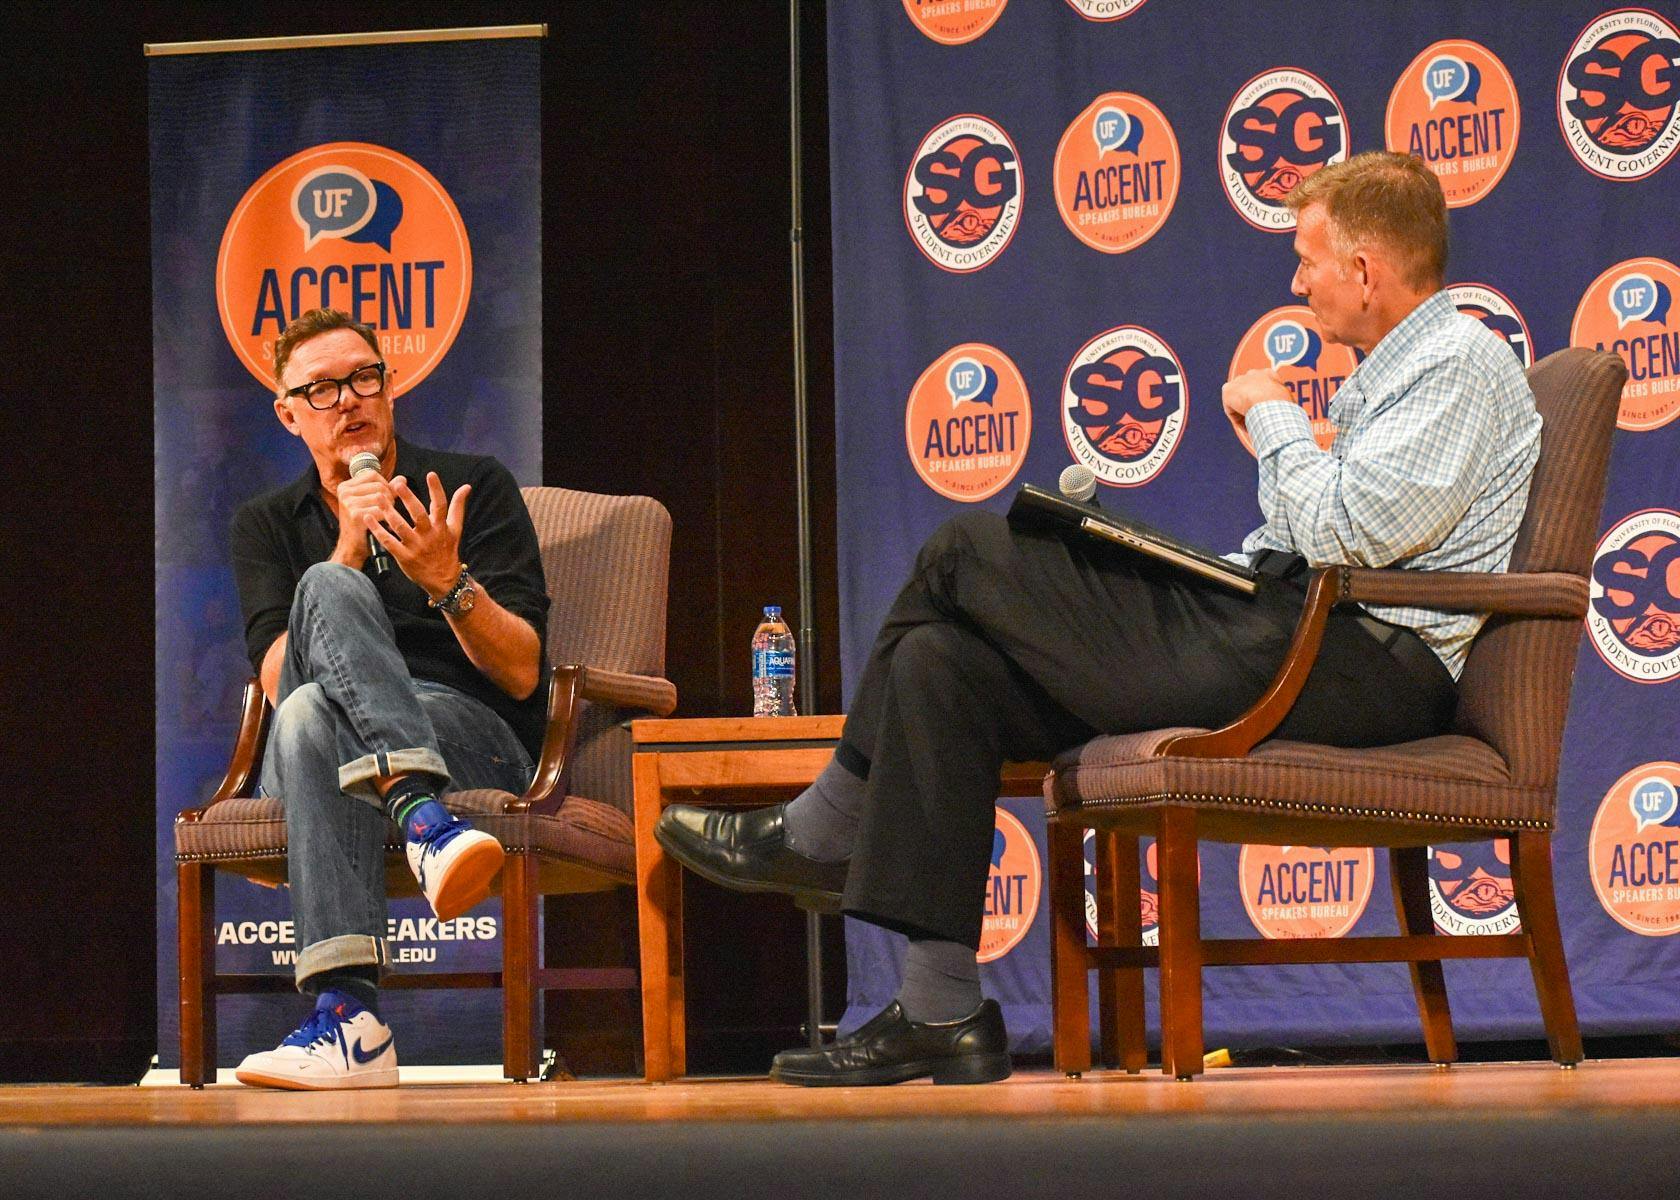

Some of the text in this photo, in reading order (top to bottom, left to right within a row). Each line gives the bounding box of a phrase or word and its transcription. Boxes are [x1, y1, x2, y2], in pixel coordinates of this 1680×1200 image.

[1583, 19, 1621, 49] UNIVERSITY
[1636, 18, 1663, 35] FLORIDA
[1241, 77, 1278, 106] UNIVERSITY
[1290, 76, 1317, 95] FLORIDA
[1432, 68, 1455, 88] UF
[928, 123, 962, 151] UNIVERSITY
[1100, 120, 1118, 139] UF
[1227, 97, 1341, 172] SG
[1410, 108, 1505, 161] ACCENT
[1569, 115, 1680, 172] STUDENT GOVERNME
[912, 143, 1017, 215] SG
[1463, 155, 1497, 173] BUREAU
[1073, 160, 1166, 211] ACCENT
[1229, 172, 1269, 221] STUDENT
[313, 188, 352, 219] UF
[1078, 204, 1159, 226] SPEAKERS BUREAU
[914, 204, 1016, 264] STUDENT GOVERNMENT
[252, 261, 445, 336] ACCENT
[1475, 293, 1501, 311] FLORIDA
[1622, 287, 1646, 308] UF
[378, 335, 426, 356] REAU
[1085, 335, 1124, 361] UNIVERSITY
[1275, 334, 1296, 354] UF
[955, 371, 974, 389] UF
[1068, 356, 1180, 426] SG
[1651, 379, 1680, 395] BUREA
[1284, 376, 1345, 420] ENT
[924, 411, 1018, 458] ACCENT
[1070, 417, 1179, 478] STUDENT GOVERNMENT
[929, 454, 1011, 473] SPEAKERS BUREAU
[1610, 519, 1650, 548] UNIVERSITY
[1662, 518, 1680, 530] FLOR
[1593, 617, 1639, 671] STUDENT
[1642, 791, 1664, 811] UF
[1609, 840, 1679, 888] ACCE
[983, 875, 1028, 916] ENT
[1257, 860, 1359, 905] ACCENT
[1613, 887, 1663, 904] SPEAKERS
[1262, 904, 1349, 920] SPEAKERS BUREAU
[1466, 911, 1520, 935] GOVERN
